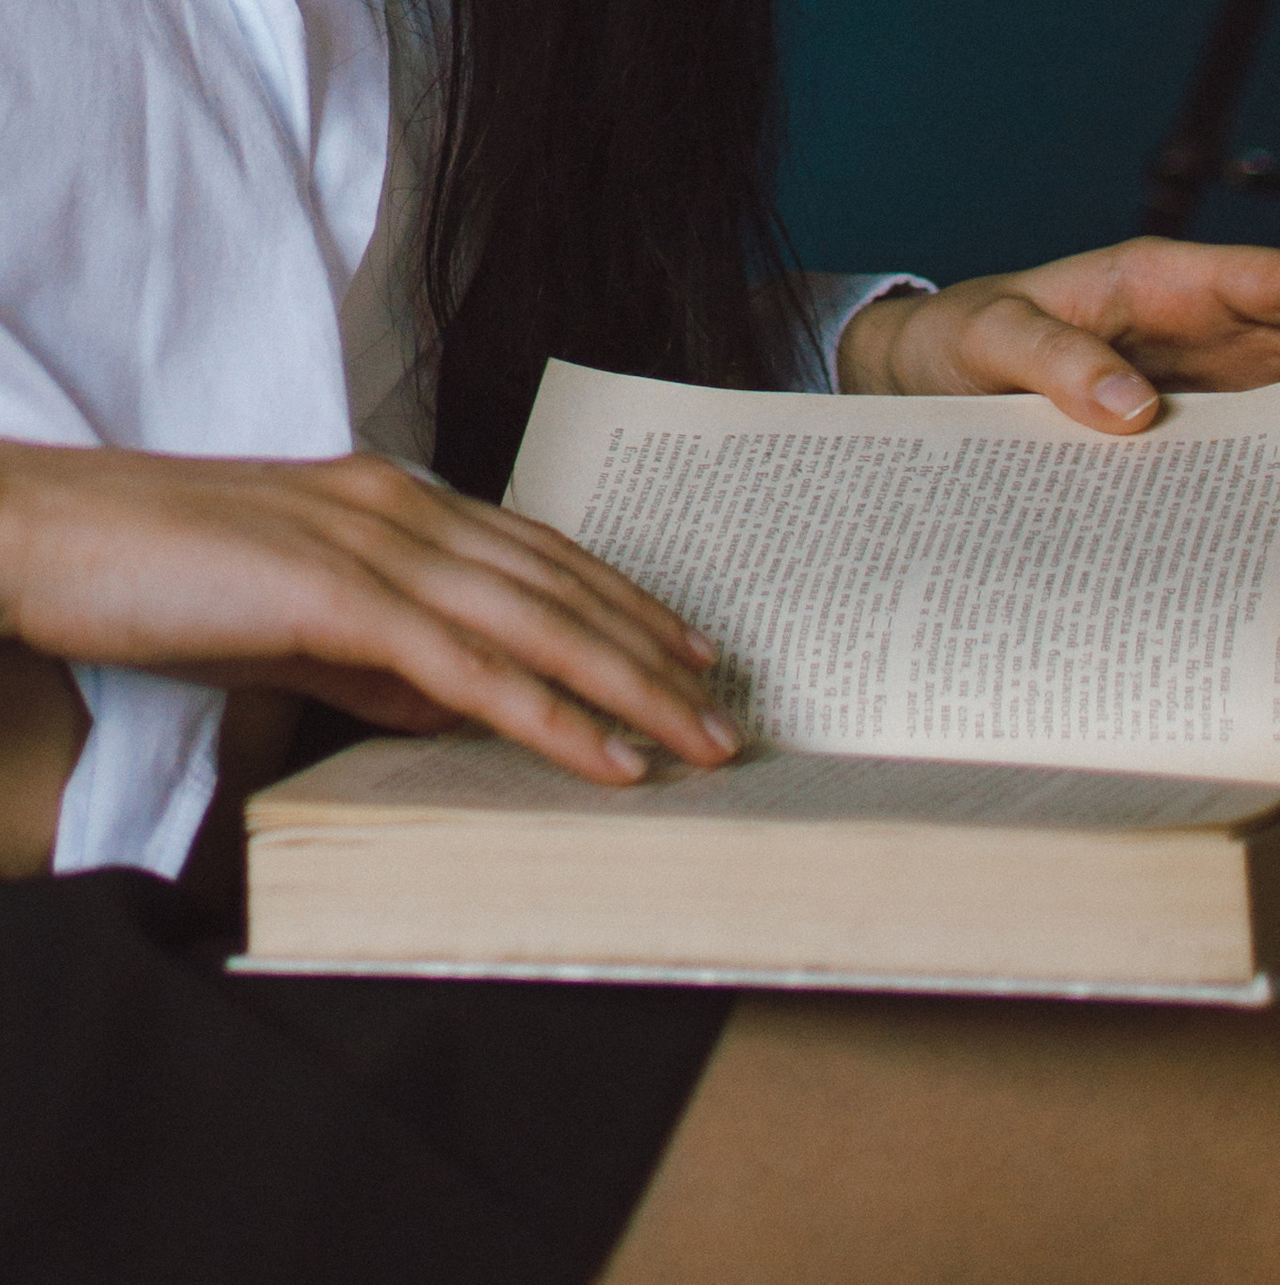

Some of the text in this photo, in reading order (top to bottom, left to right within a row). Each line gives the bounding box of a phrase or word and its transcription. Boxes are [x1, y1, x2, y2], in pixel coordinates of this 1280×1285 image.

[981, 632, 992, 645] за
[1029, 609, 1047, 671] школьное
[1050, 606, 1065, 642] чтобы
[1066, 621, 1079, 649] этой
[1083, 624, 1096, 646] как
[1100, 606, 1119, 653] больше
[776, 620, 795, 678] назначит
[927, 622, 943, 675] которые
[1116, 640, 1128, 665] мне
[1134, 629, 1147, 665] здесь
[1150, 638, 1164, 646] у
[1204, 613, 1219, 669] старшая
[725, 652, 739, 685] если
[757, 658, 771, 690] пока
[808, 662, 820, 689] вам
[909, 659, 920, 683] это
[1012, 655, 1023, 673] но
[1045, 648, 1061, 683] быть
[1150, 655, 1162, 689] меня
[1185, 659, 1201, 680] Но
[772, 684, 784, 710] вас
[823, 686, 838, 698] Я
[841, 676, 851, 697] мы
[855, 650, 871, 738] оставайтесь
[958, 680, 969, 698] ни
[991, 631, 1009, 740] скороговоркой
[1061, 658, 1075, 740] должности
[1096, 658, 1109, 721] прежней
[1130, 671, 1142, 702] уже
[1166, 675, 1179, 722] чтобы
[1183, 685, 1195, 711] все
[1009, 696, 1019, 740] часто
[1148, 698, 1162, 740] были
[1199, 676, 1213, 741] кухарка
[974, 711, 985, 739] так
[1184, 718, 1195, 741] же
